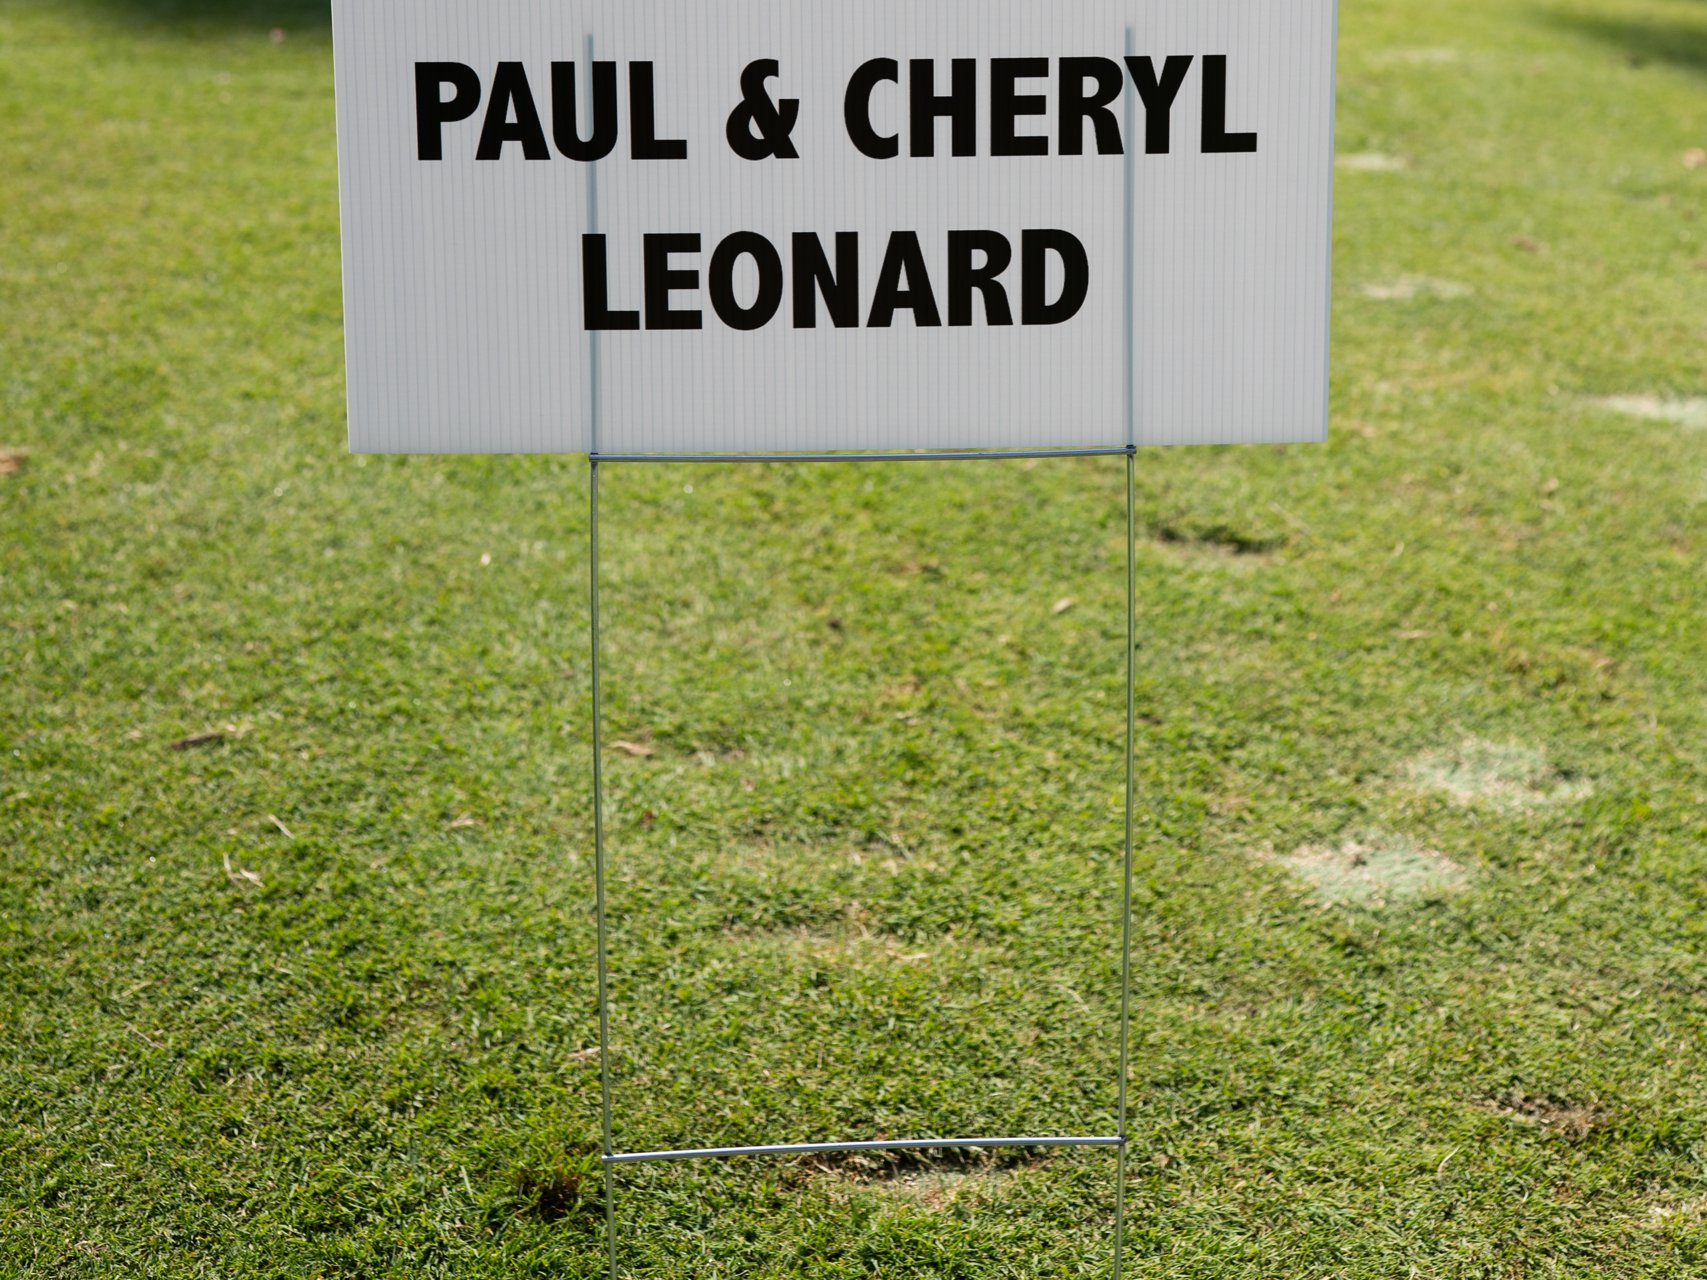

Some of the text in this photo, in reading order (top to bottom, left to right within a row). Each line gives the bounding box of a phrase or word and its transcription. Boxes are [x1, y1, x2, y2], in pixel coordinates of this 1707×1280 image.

[414, 54, 1258, 163] PAUL & CHERYL
[582, 228, 1089, 331] LEONARD
